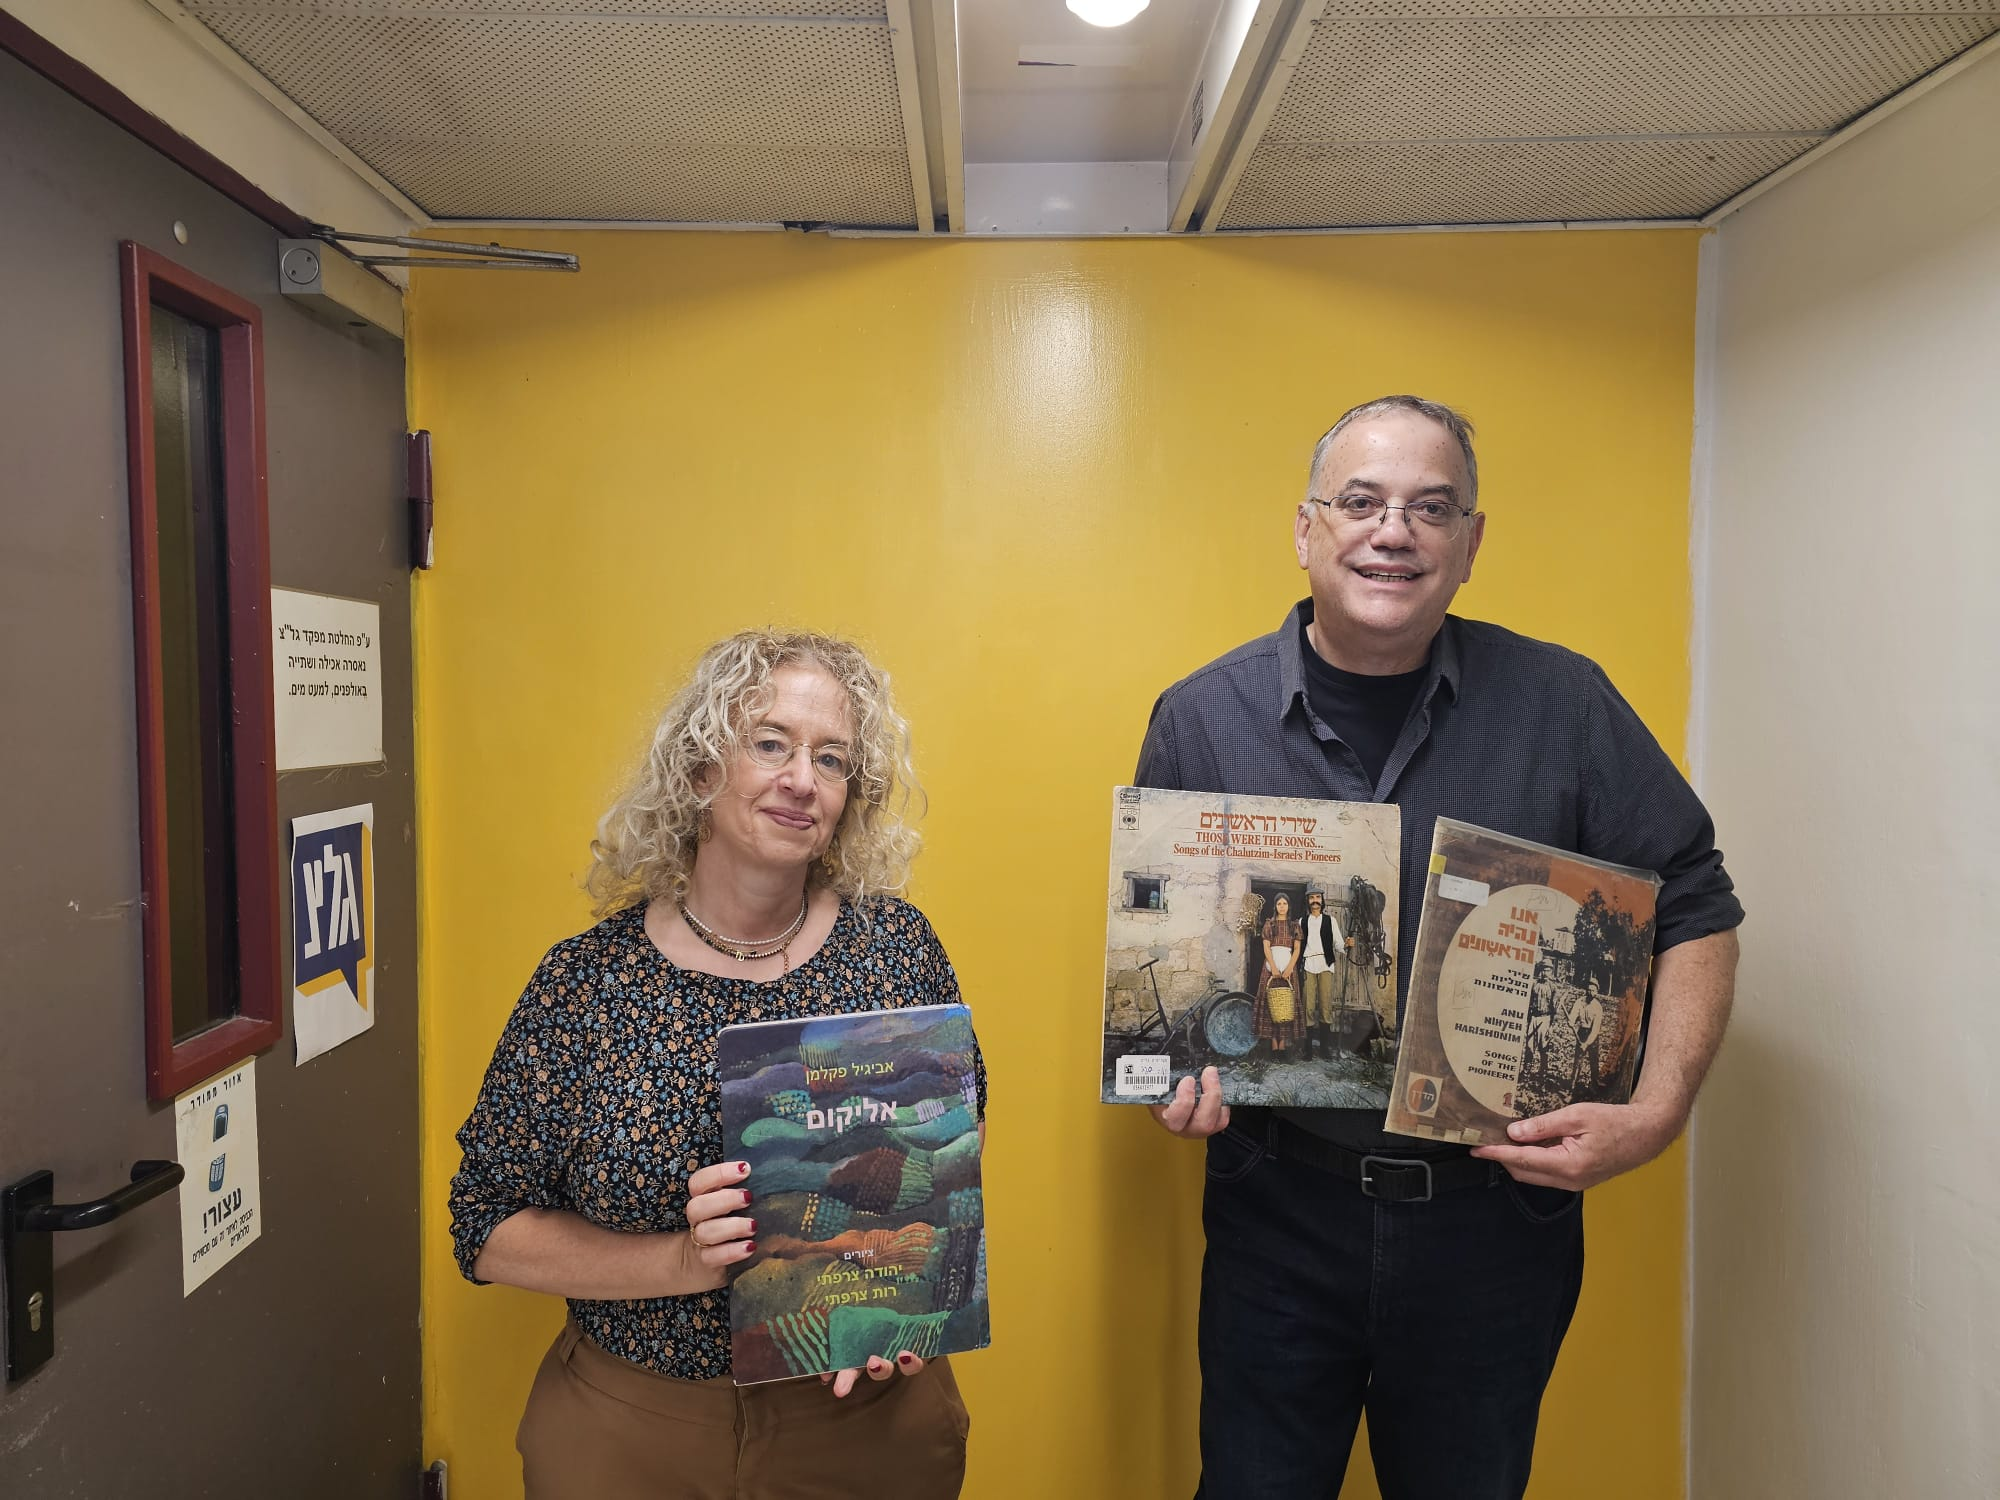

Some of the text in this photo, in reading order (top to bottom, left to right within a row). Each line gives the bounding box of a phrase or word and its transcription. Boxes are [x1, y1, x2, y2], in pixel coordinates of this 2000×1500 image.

[278, 623, 371, 648] ע"פ החלטת מפקד גל"צ
[288, 654, 366, 672] נאסרה אכילה ושתייה
[288, 680, 368, 698] באולפנים, למעט מים.
[1199, 811, 1318, 834] שירי הראשונים
[1230, 833, 1261, 846] WERE
[1263, 835, 1283, 847] THE
[1284, 836, 1324, 849] SONGS...
[1173, 843, 1200, 857] Songs
[1200, 844, 1211, 856] of
[1213, 845, 1225, 857] the
[1305, 850, 1342, 863] Pioneers
[1510, 906, 1539, 925] אנו
[1498, 922, 1537, 946] נהיה
[1491, 974, 1529, 989] העליות
[1507, 968, 1531, 980] שירי
[1473, 978, 1528, 998] הראשונות
[1501, 1008, 1525, 1020] ANU
[1454, 1022, 1521, 1043] HARISHONIM
[1483, 1016, 1523, 1032] NIHYEH
[1481, 1059, 1517, 1072] OF THE
[1484, 1050, 1518, 1063] SONGS
[805, 1060, 895, 1085] אביגיל פקלמן
[1467, 1066, 1515, 1082] PIONEERS
[806, 1096, 899, 1133] אליקום
[203, 1187, 242, 1235] עצור!
[843, 1248, 875, 1261] ציורים
[816, 1264, 904, 1286] יהודה צרפתי
[824, 1286, 898, 1305] רות צרפתי
